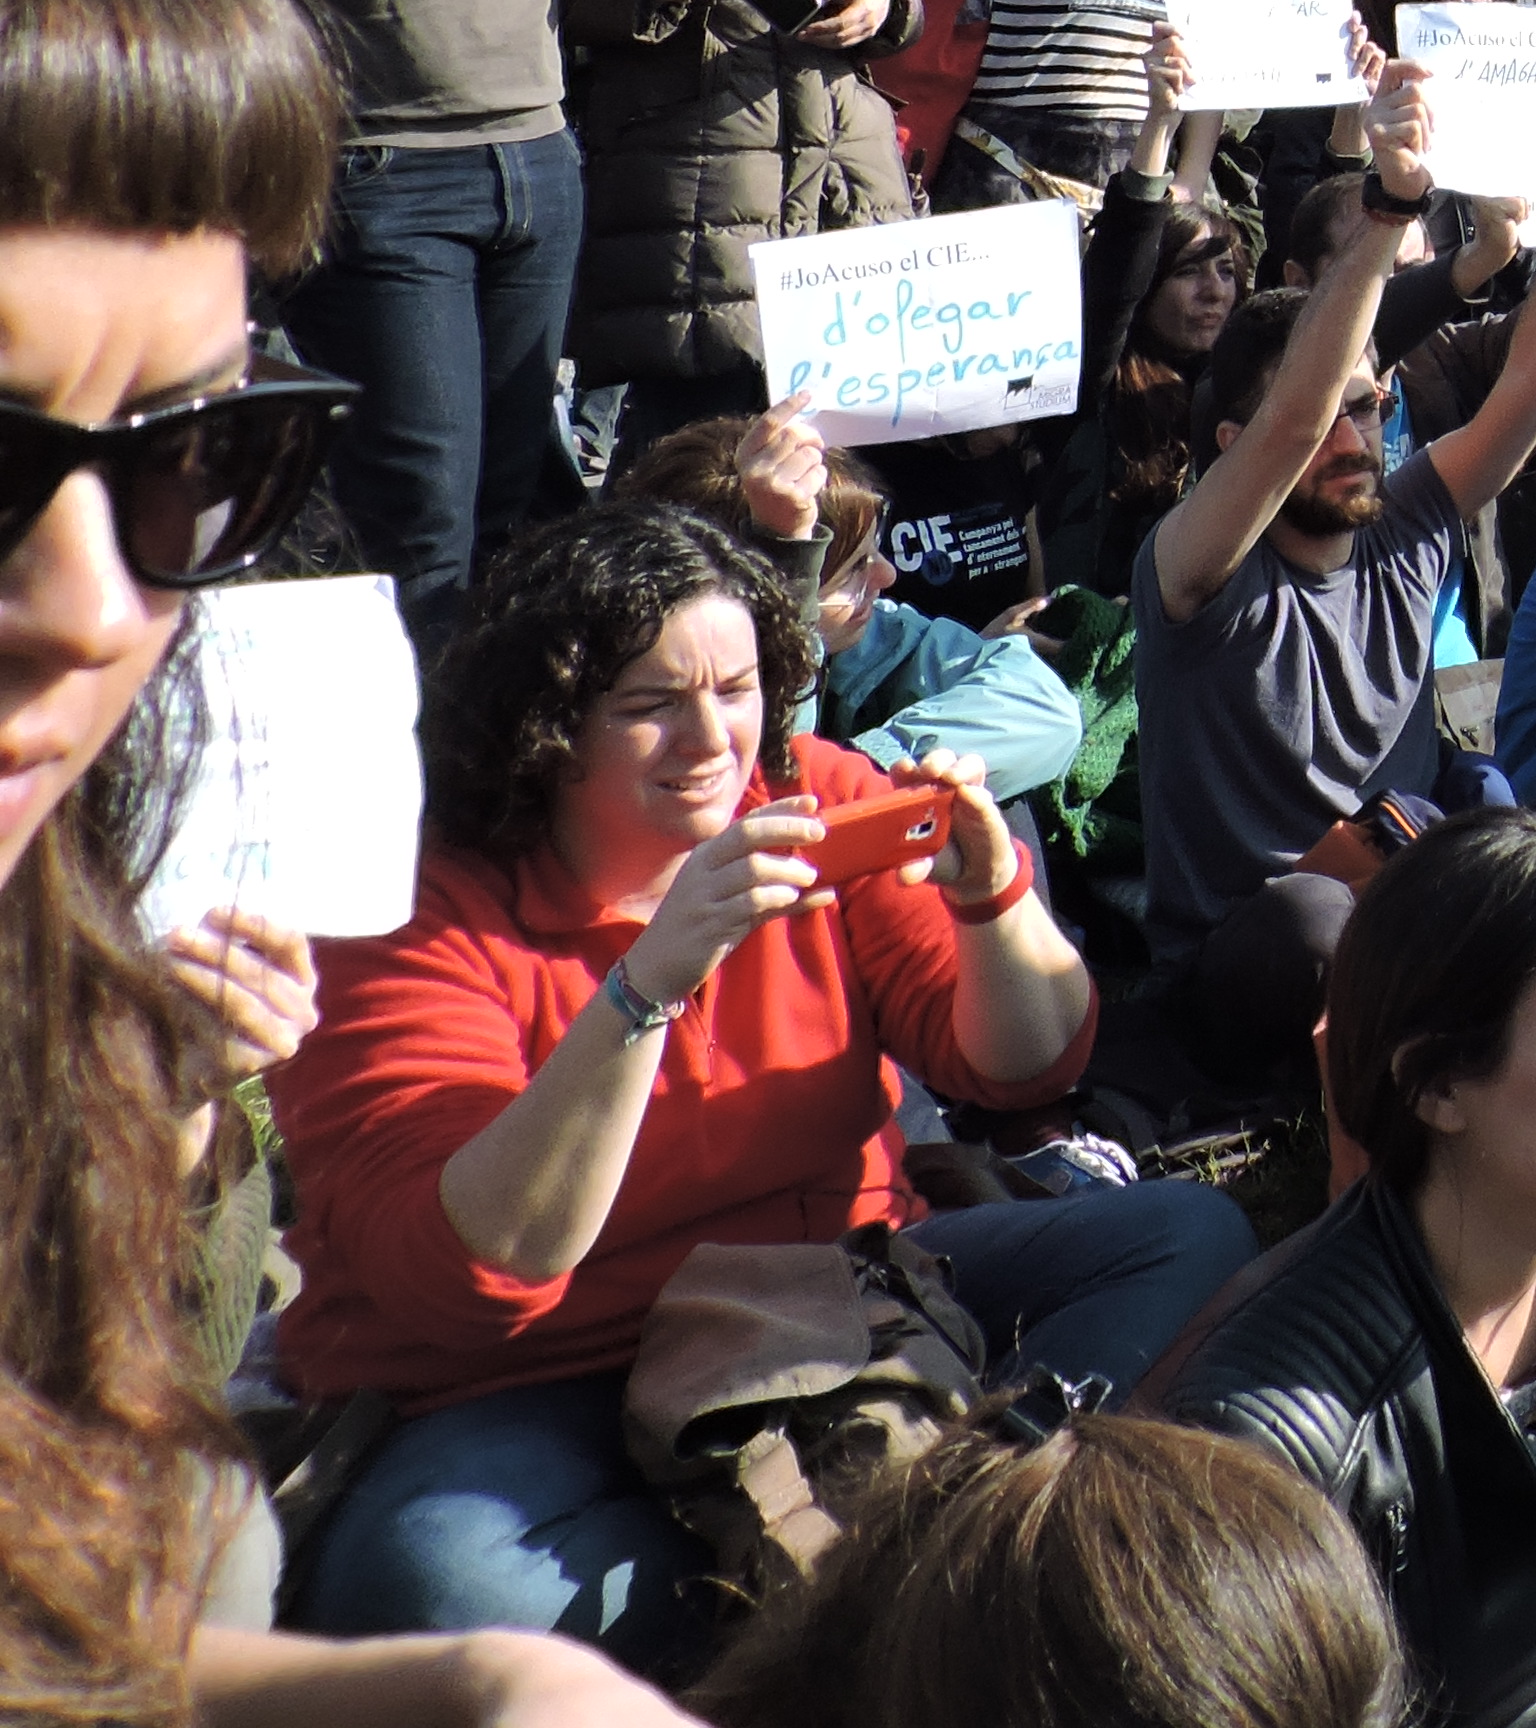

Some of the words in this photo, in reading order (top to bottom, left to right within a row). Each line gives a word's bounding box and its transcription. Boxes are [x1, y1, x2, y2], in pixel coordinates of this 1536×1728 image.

[780, 258, 893, 291] #JoAcuso
[899, 252, 919, 272] el
[890, 514, 963, 573] CIE
